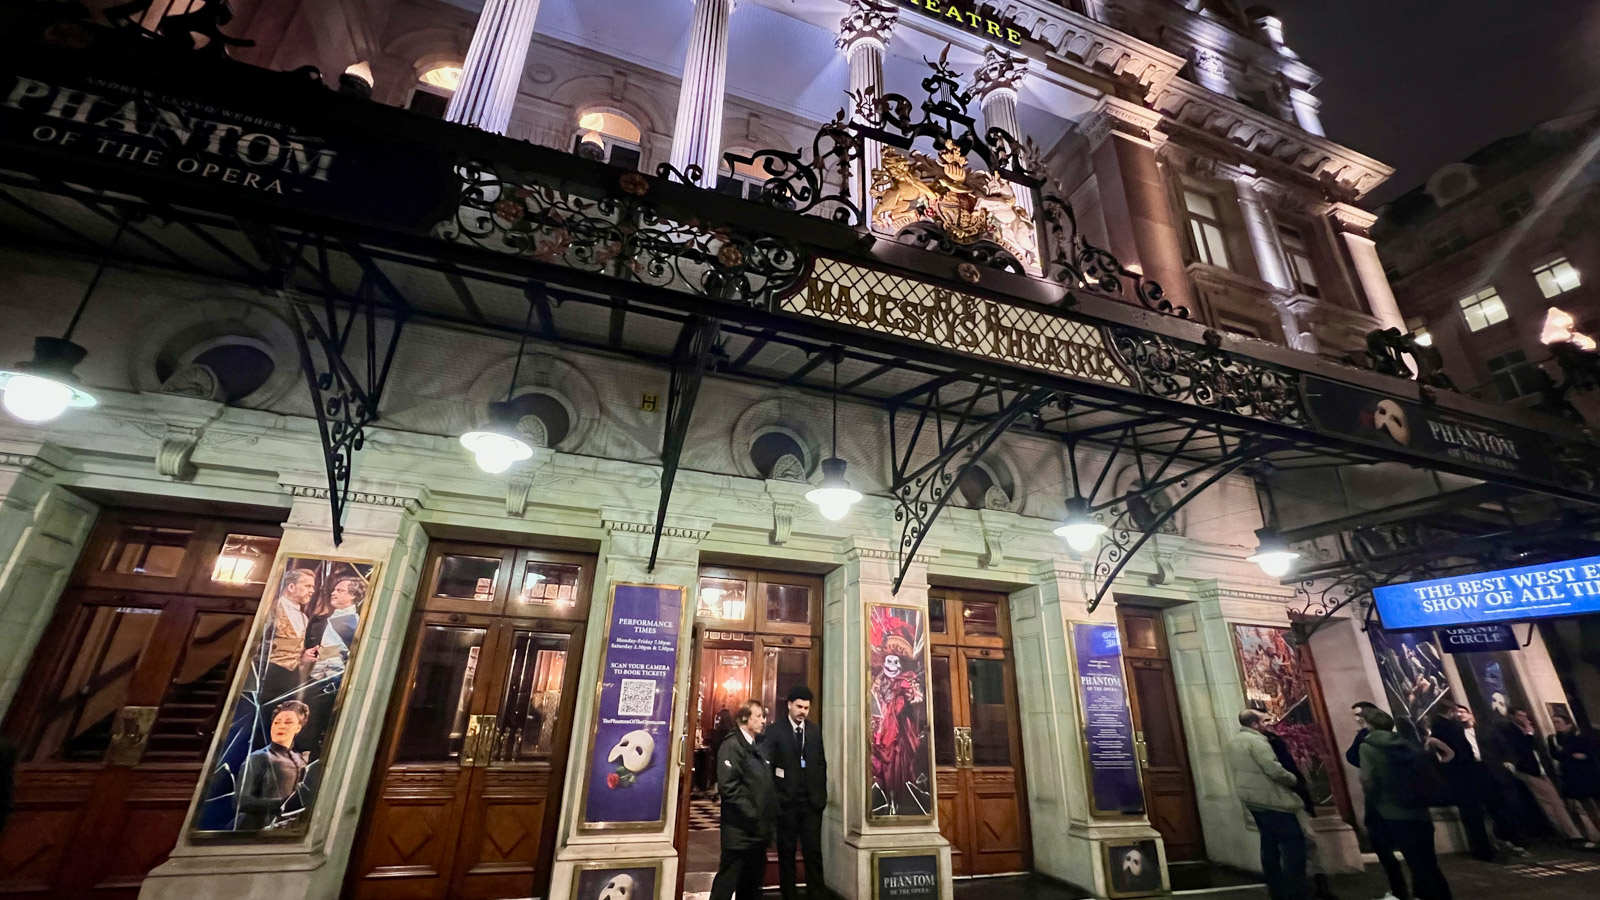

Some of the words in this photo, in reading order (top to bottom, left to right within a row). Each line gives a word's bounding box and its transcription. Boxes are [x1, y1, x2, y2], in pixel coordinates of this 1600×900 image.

[911, 0, 1023, 45] EATRE
[3, 76, 338, 182] PHANTOM
[32, 125, 81, 146] OF
[97, 137, 164, 167] THE
[176, 157, 285, 195] OPERA
[934, 287, 1000, 330] HER
[987, 322, 1114, 377] THEATRE
[1427, 420, 1520, 459] PHANTOM
[1414, 584, 1453, 601] THE
[1457, 577, 1506, 595] BEST
[1510, 567, 1576, 588] WEST
[1422, 594, 1479, 613] SHOW
[1485, 591, 1514, 606] OF
[1521, 585, 1565, 603] ALL
[618, 617, 673, 628] PERFORMANCE
[633, 626, 657, 634] TIMES
[616, 637, 653, 646] Monday-Friday
[1449, 633, 1502, 645] CIRCLE
[1081, 676, 1121, 687] PHANTOM
[883, 875, 936, 889] PHANTOM
